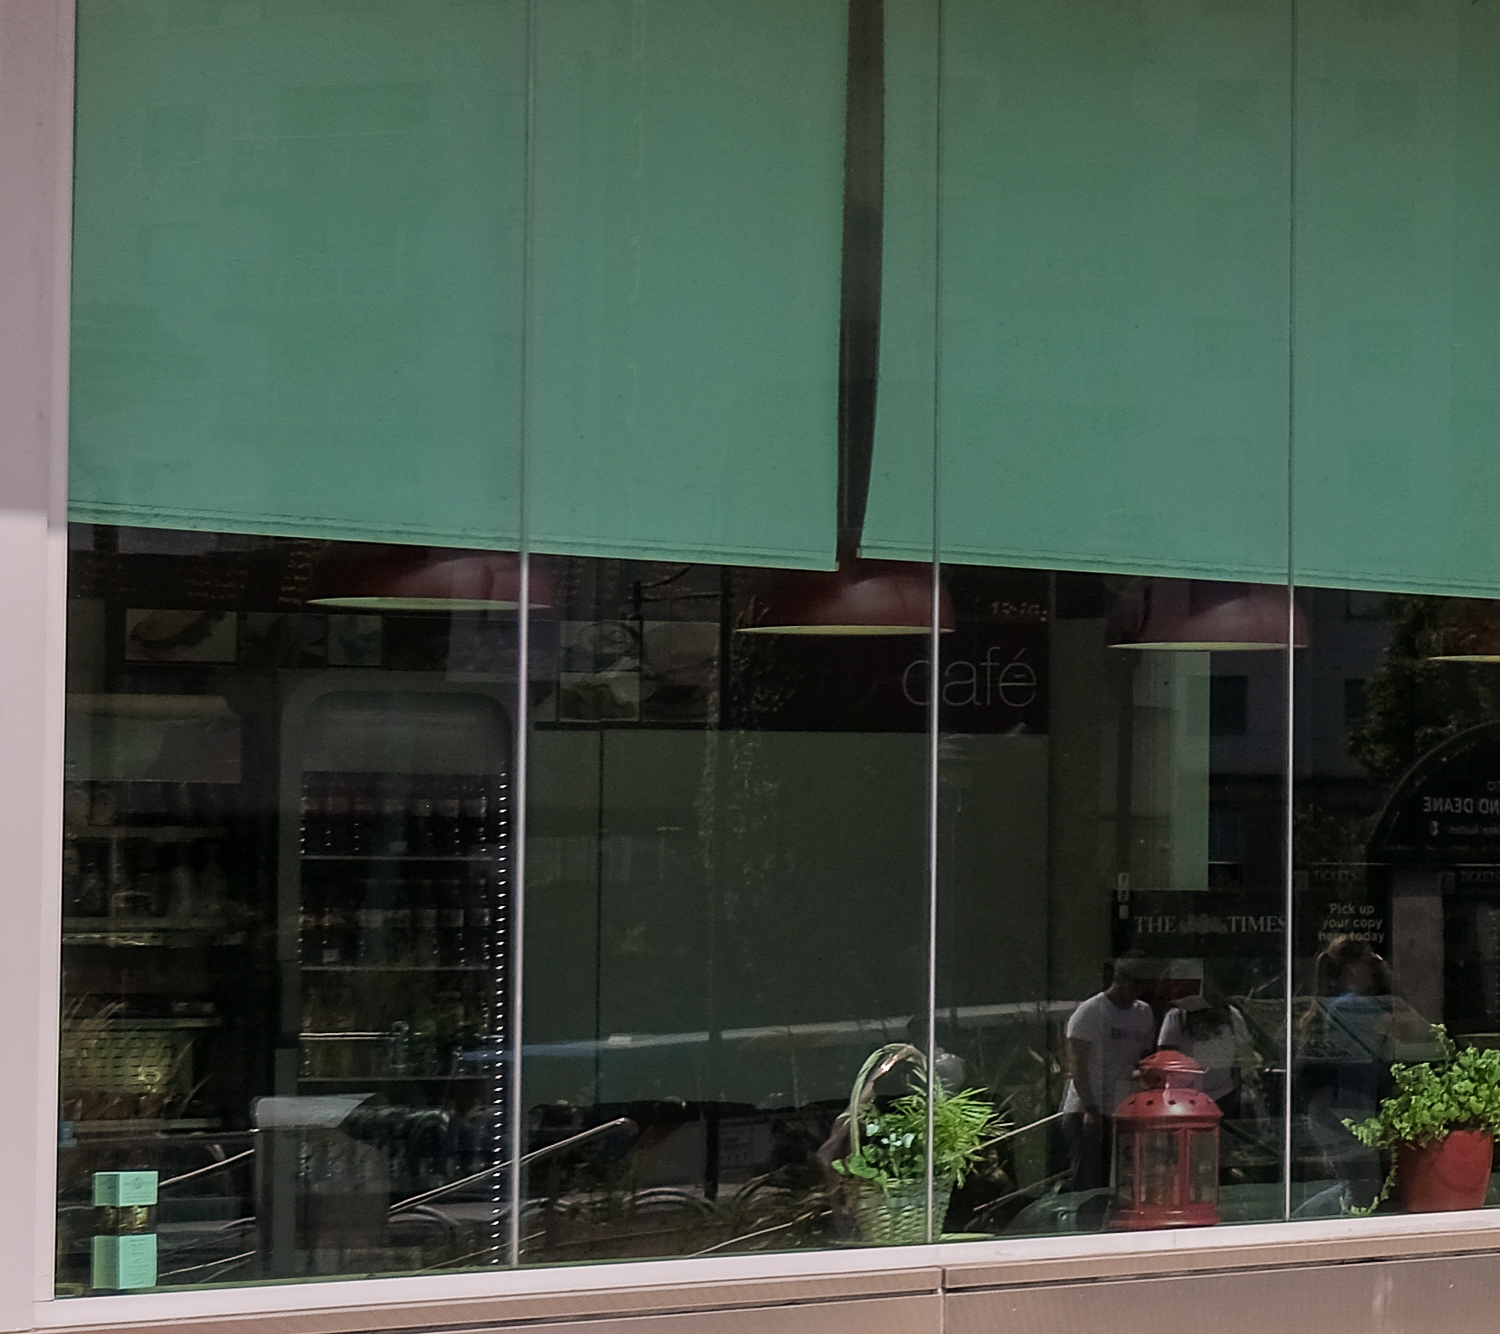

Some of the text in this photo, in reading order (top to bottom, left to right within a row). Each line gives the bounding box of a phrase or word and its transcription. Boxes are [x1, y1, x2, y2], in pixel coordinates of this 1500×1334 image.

[902, 646, 1036, 707] café
[1329, 902, 1375, 916] Pick up
[1134, 913, 1286, 934] THE TIMES
[1323, 918, 1383, 931] your copy
[1350, 930, 1385, 944] today
